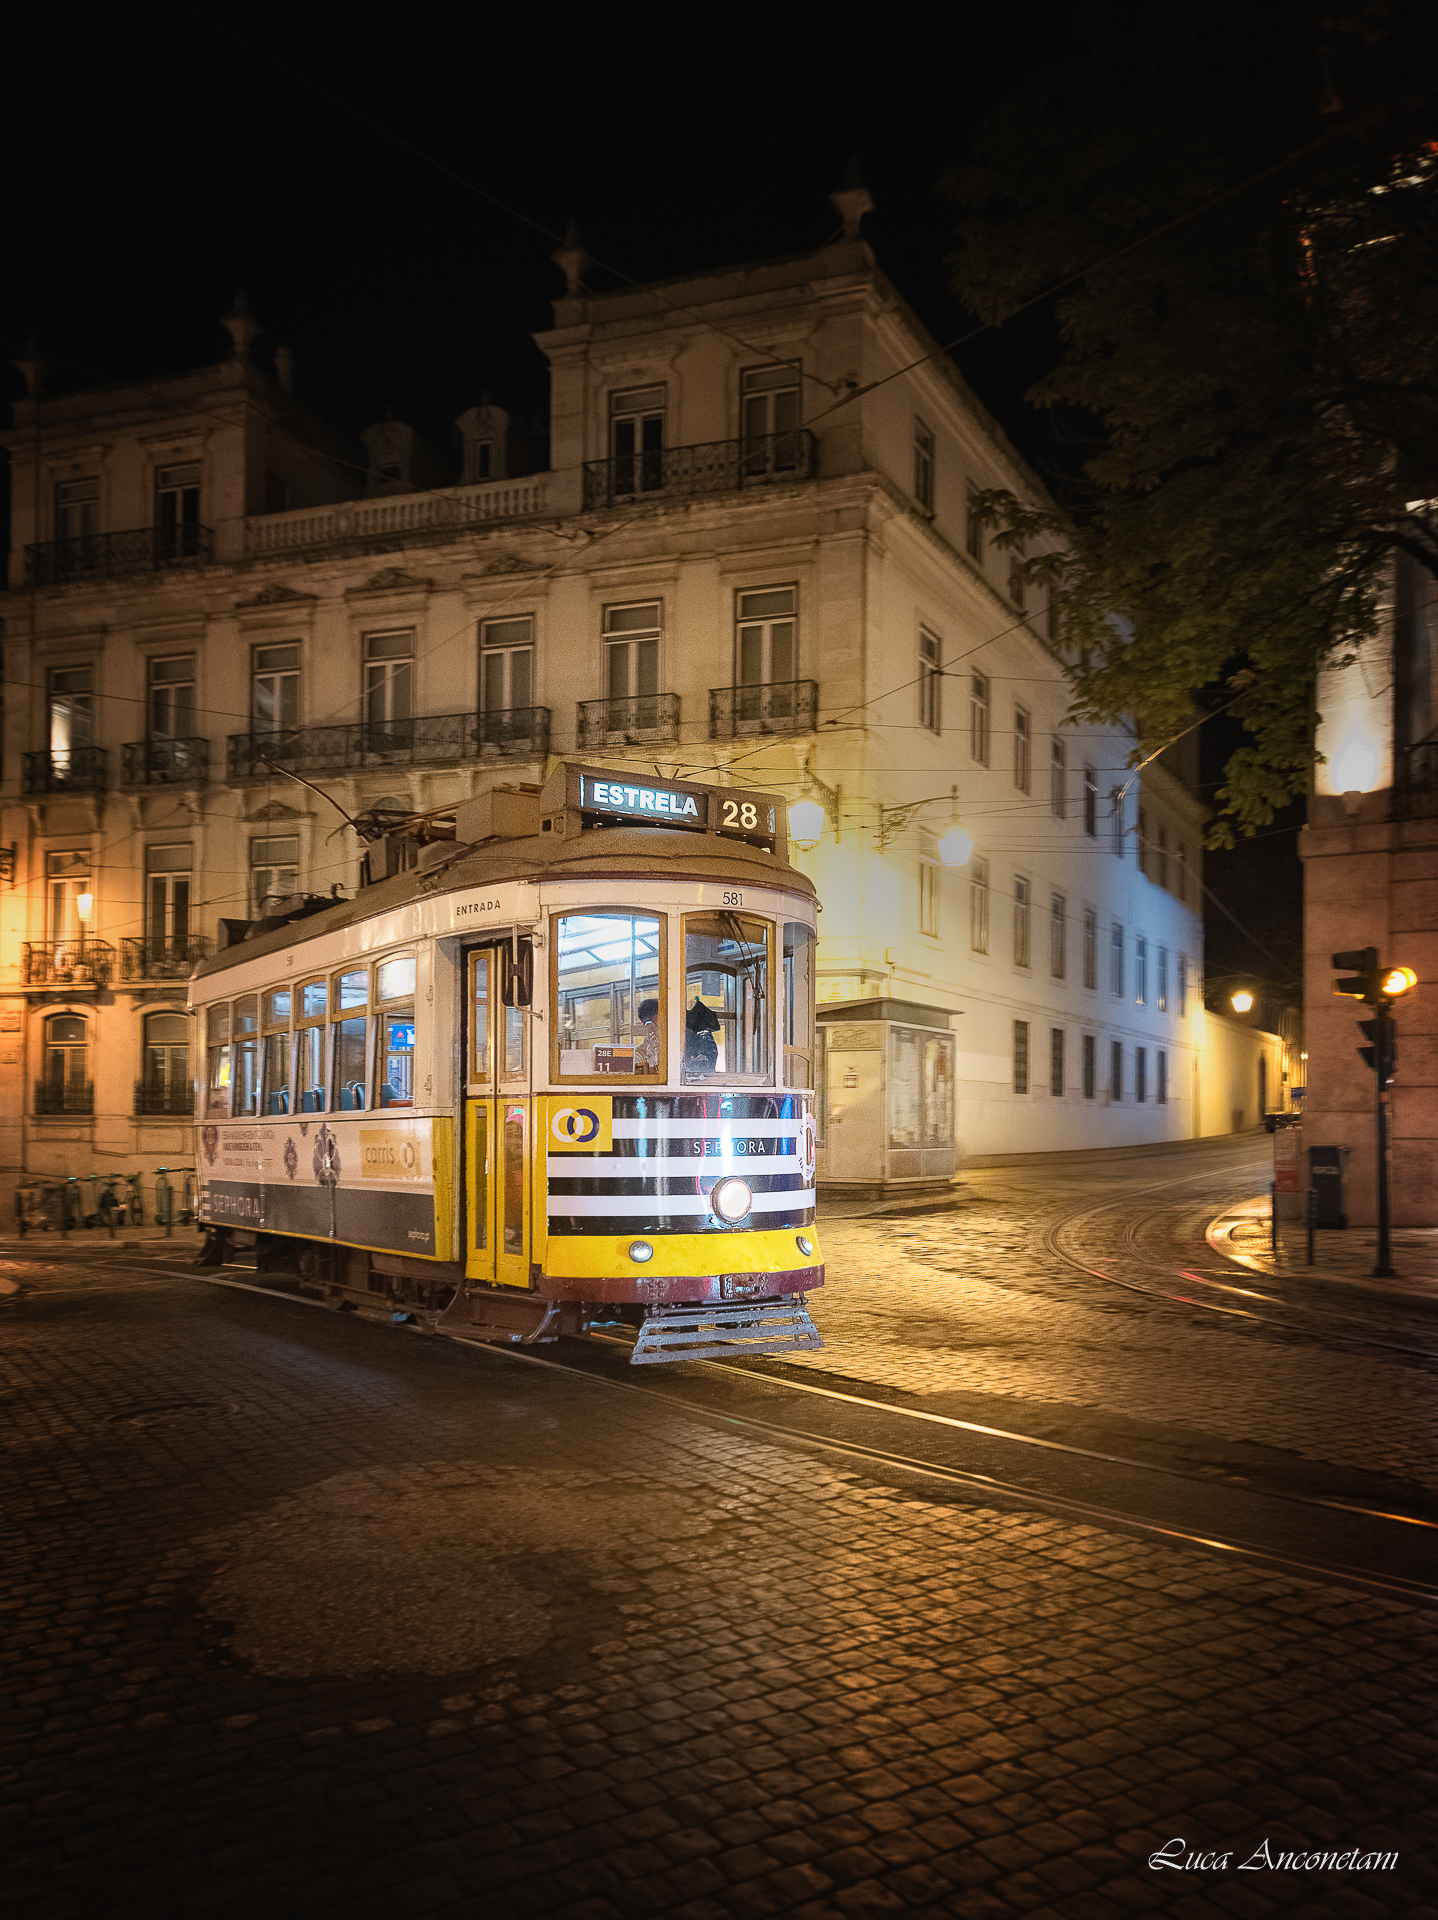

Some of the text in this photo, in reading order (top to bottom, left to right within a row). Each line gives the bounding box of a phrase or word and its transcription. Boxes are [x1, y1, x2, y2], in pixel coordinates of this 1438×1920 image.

[593, 782, 699, 817] ESTRELA
[722, 800, 758, 830] 28
[722, 891, 743, 906] 581
[456, 899, 501, 916] ENTRADA
[597, 1049, 612, 1057] 28E
[597, 1062, 610, 1072] 11
[213, 1193, 261, 1219] SEPHORA
